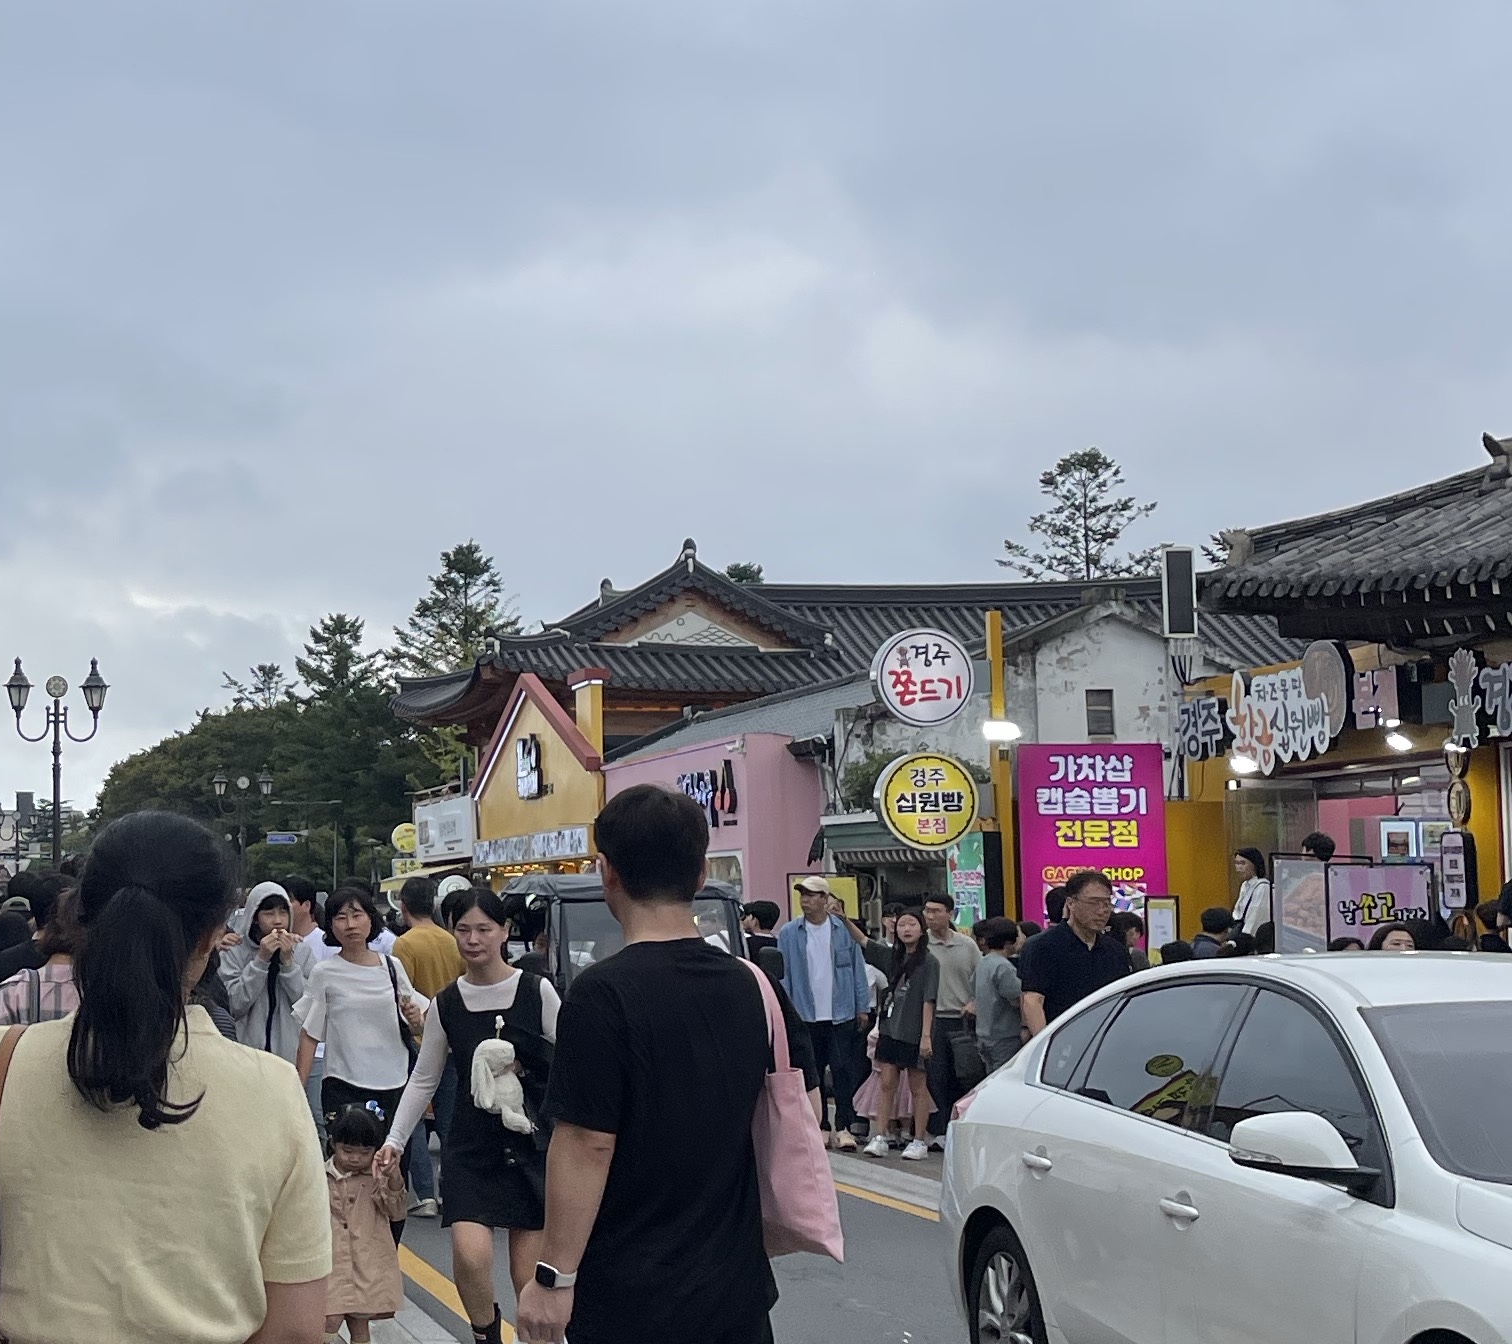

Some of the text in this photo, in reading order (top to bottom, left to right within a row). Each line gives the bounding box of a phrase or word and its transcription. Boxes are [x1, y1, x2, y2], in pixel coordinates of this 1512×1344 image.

[909, 643, 952, 668] 경주
[888, 669, 963, 706] 쫀드기
[1179, 700, 1222, 758] 경주
[909, 767, 946, 788] 경주
[1048, 754, 1134, 783] 가챠샵
[895, 791, 964, 814] 십원빵
[1036, 786, 1148, 815] 캡슐뽑기
[916, 817, 948, 835] 본점
[1055, 819, 1140, 848] 전문점
[1100, 866, 1145, 882] SHOP
